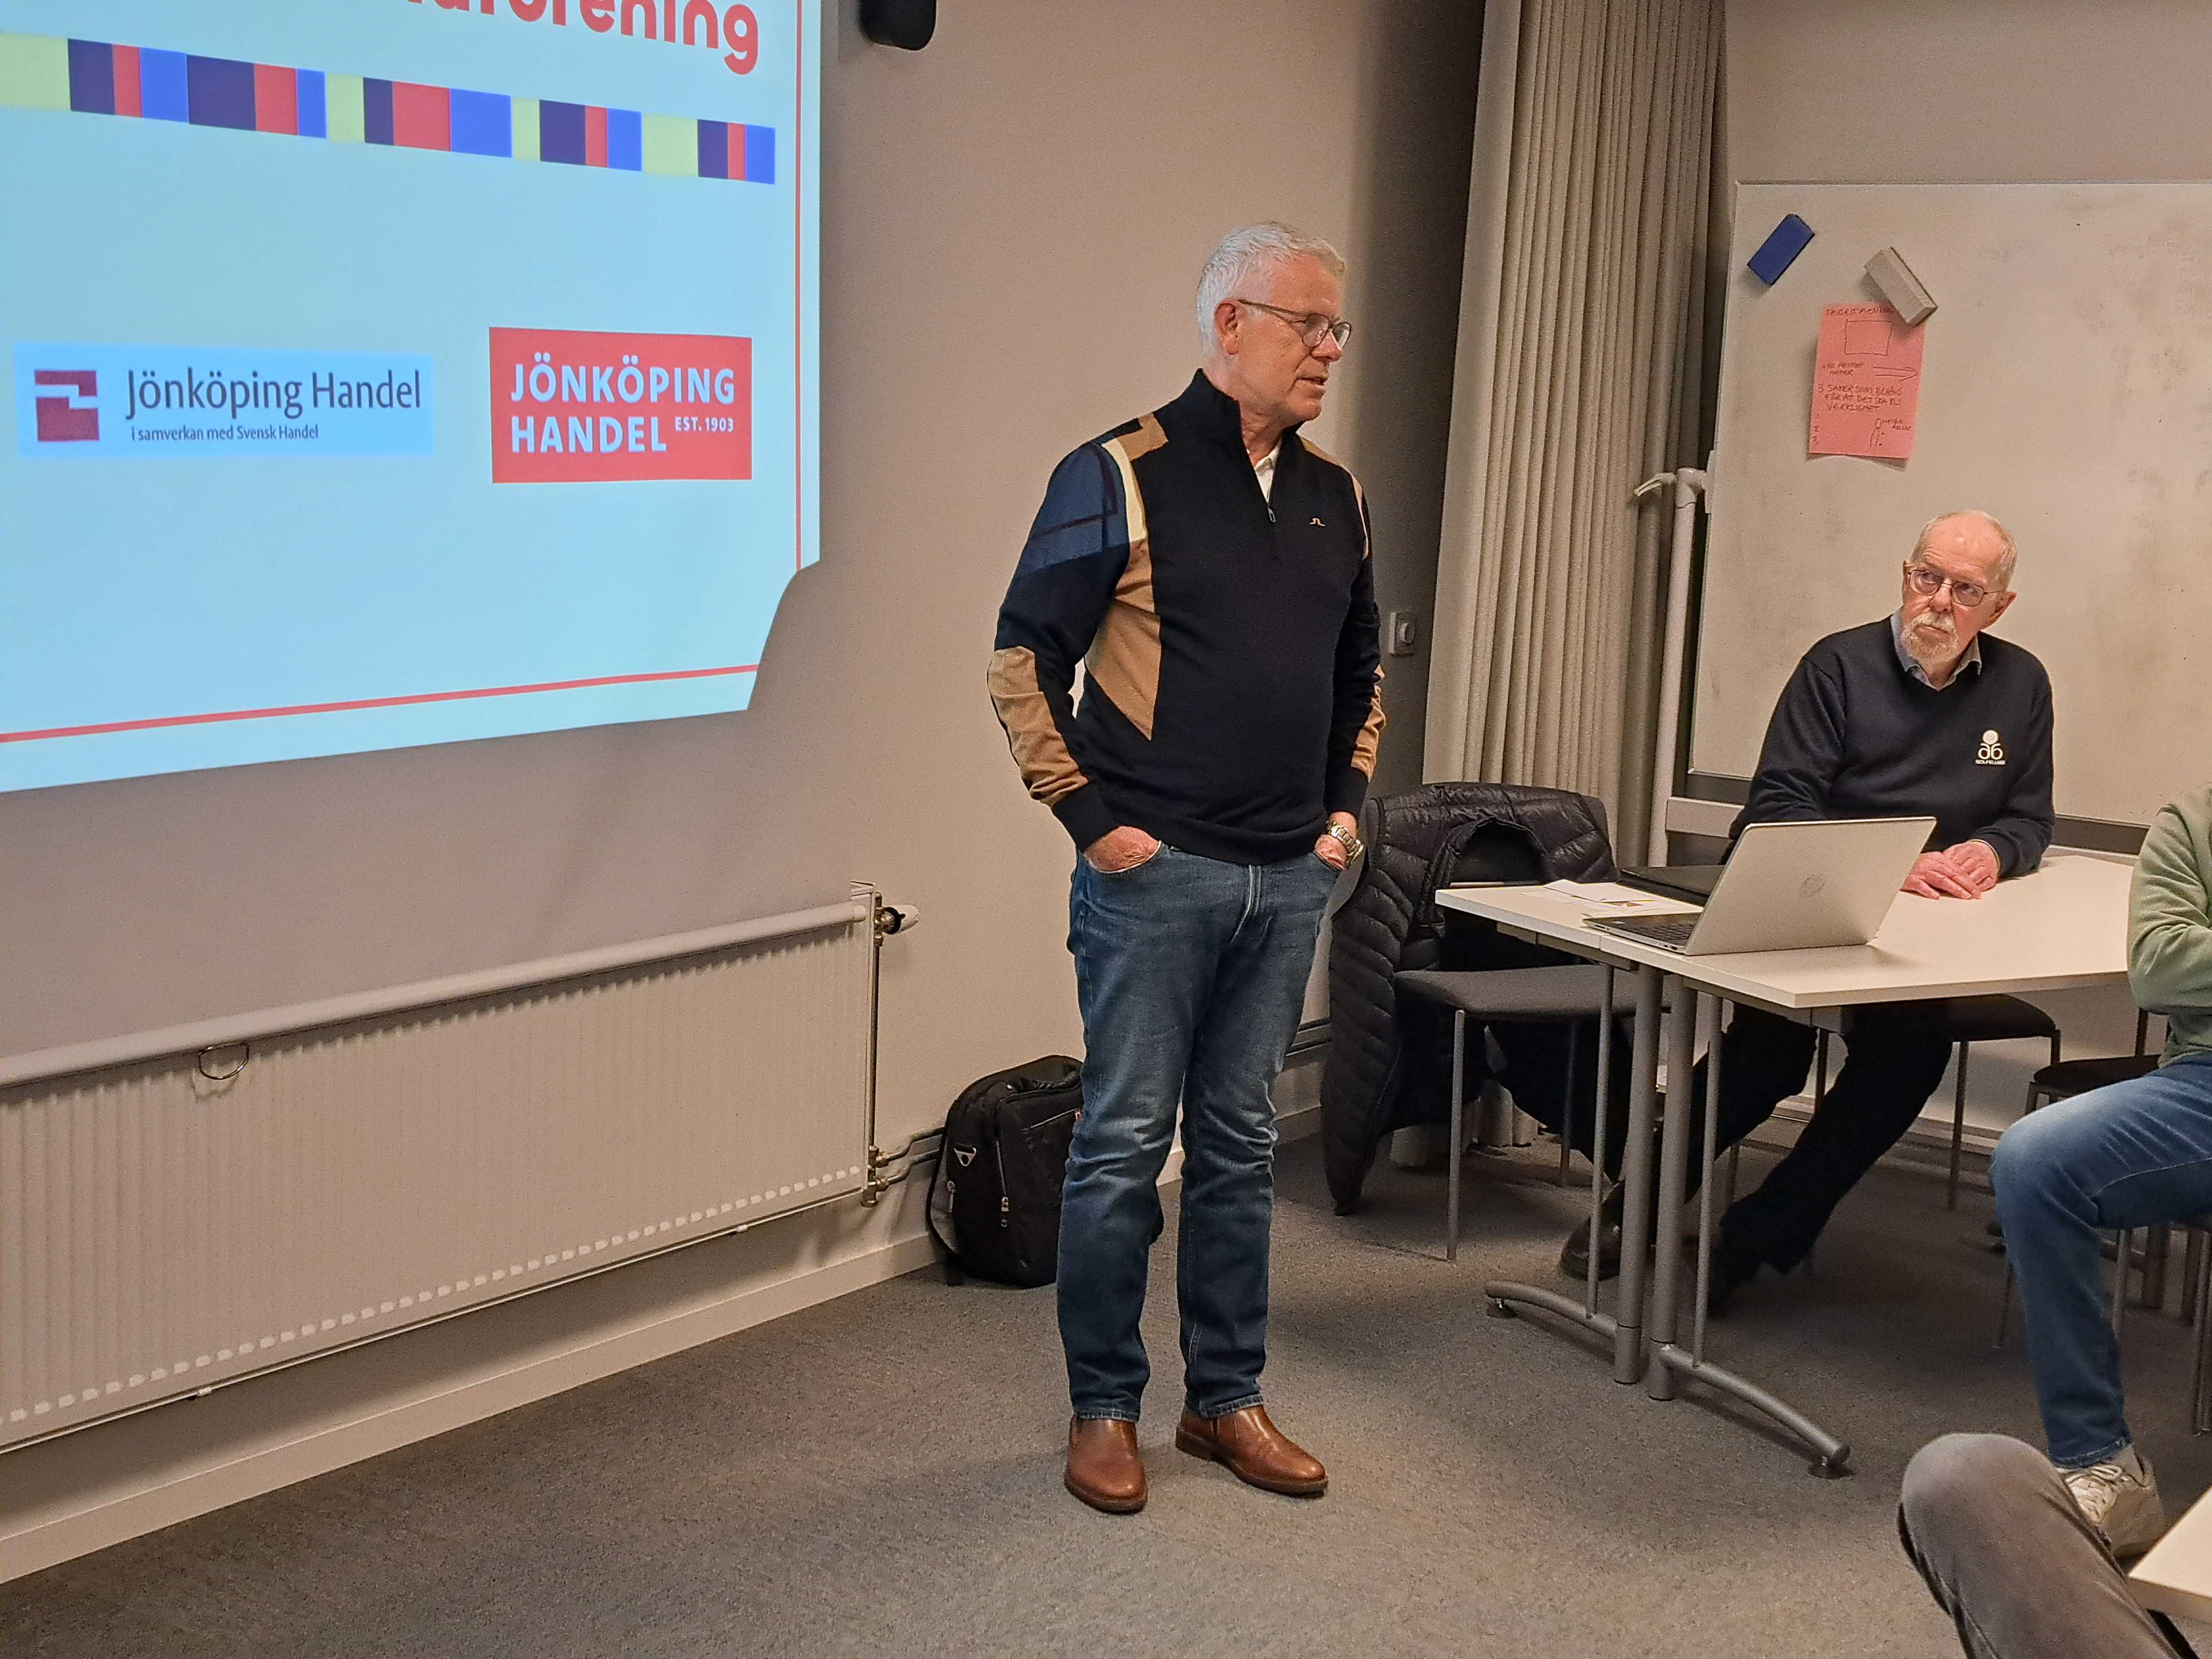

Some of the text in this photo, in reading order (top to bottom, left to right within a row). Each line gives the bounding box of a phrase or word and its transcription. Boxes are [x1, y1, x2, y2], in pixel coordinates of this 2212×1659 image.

[126, 367, 421, 420] Jönköping Handel
[511, 352, 734, 404] JÖNKÖPING
[139, 425, 204, 441] samverkan
[207, 424, 233, 440] med
[237, 424, 276, 440] Svensk
[279, 424, 319, 439] Handel
[511, 416, 667, 453] HANDEL
[675, 417, 733, 432] EST. 1903
